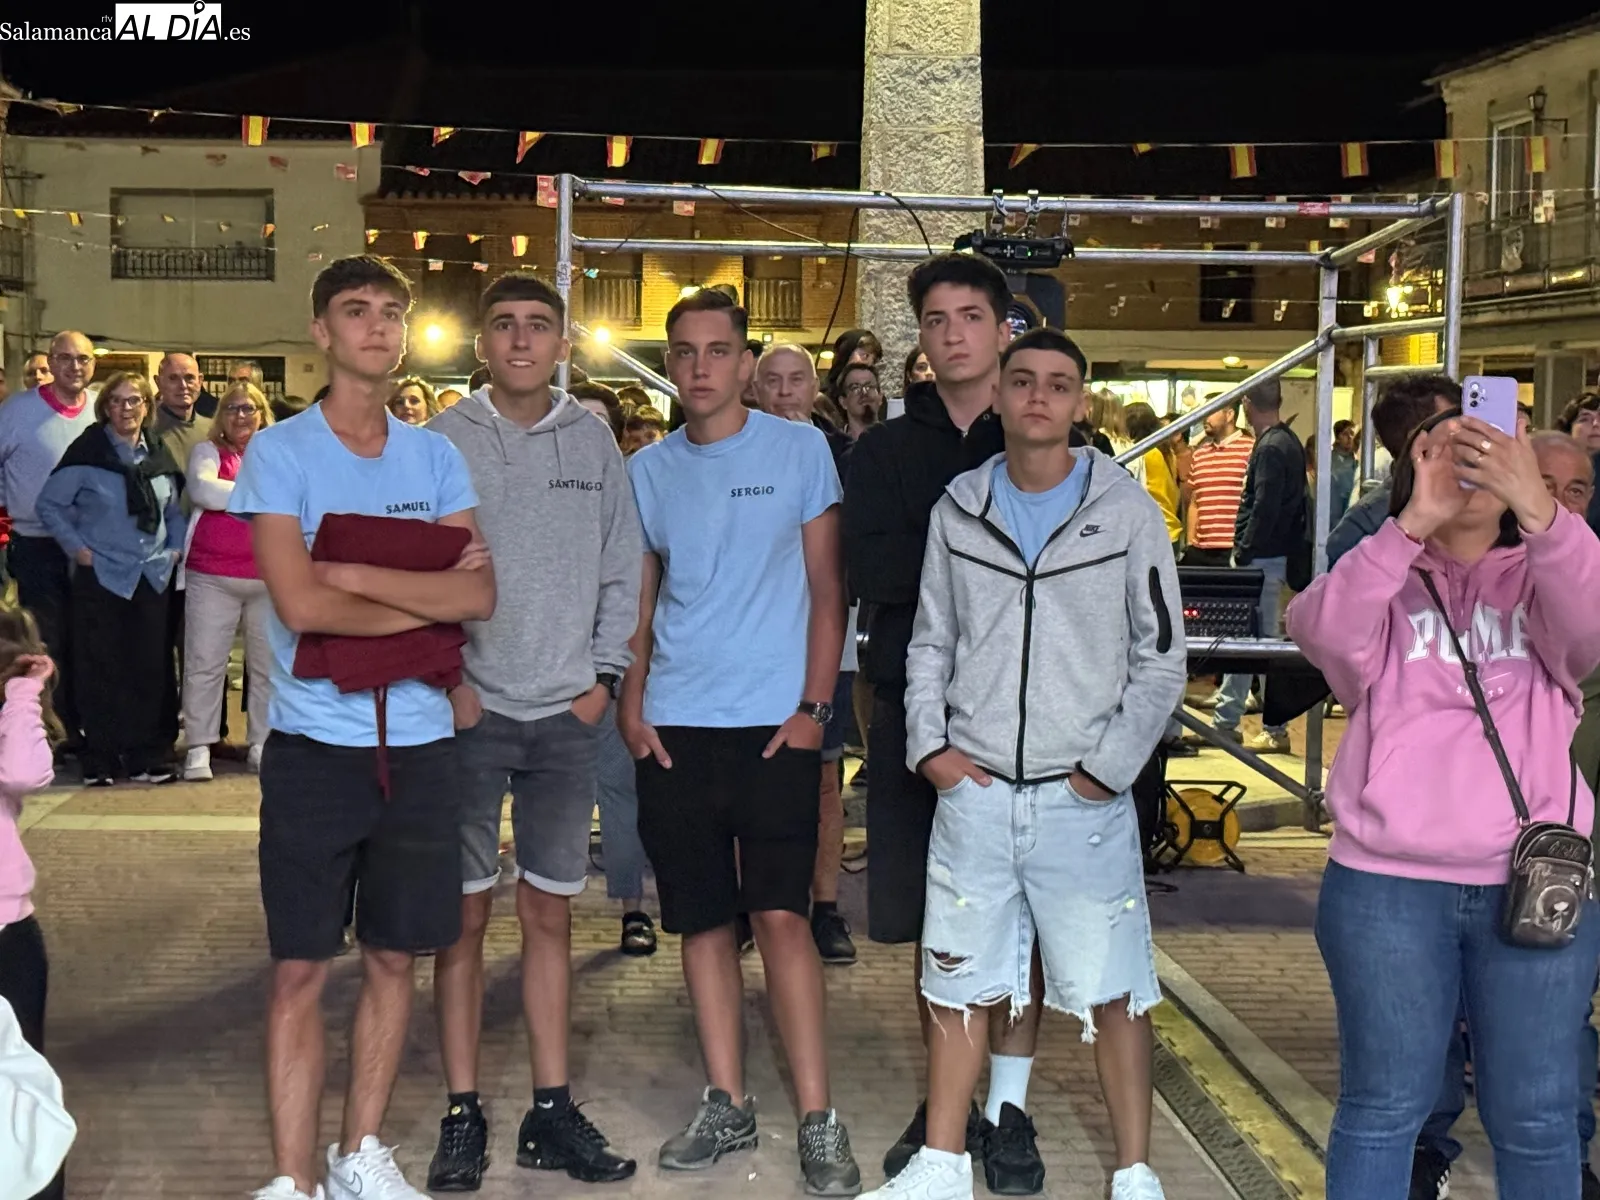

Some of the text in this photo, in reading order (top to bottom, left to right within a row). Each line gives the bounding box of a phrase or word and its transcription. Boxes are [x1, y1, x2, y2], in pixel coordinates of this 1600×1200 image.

[548, 479, 604, 492] SANTIAGO
[730, 485, 775, 498] SERGIO
[385, 501, 431, 515] SAMUEL
